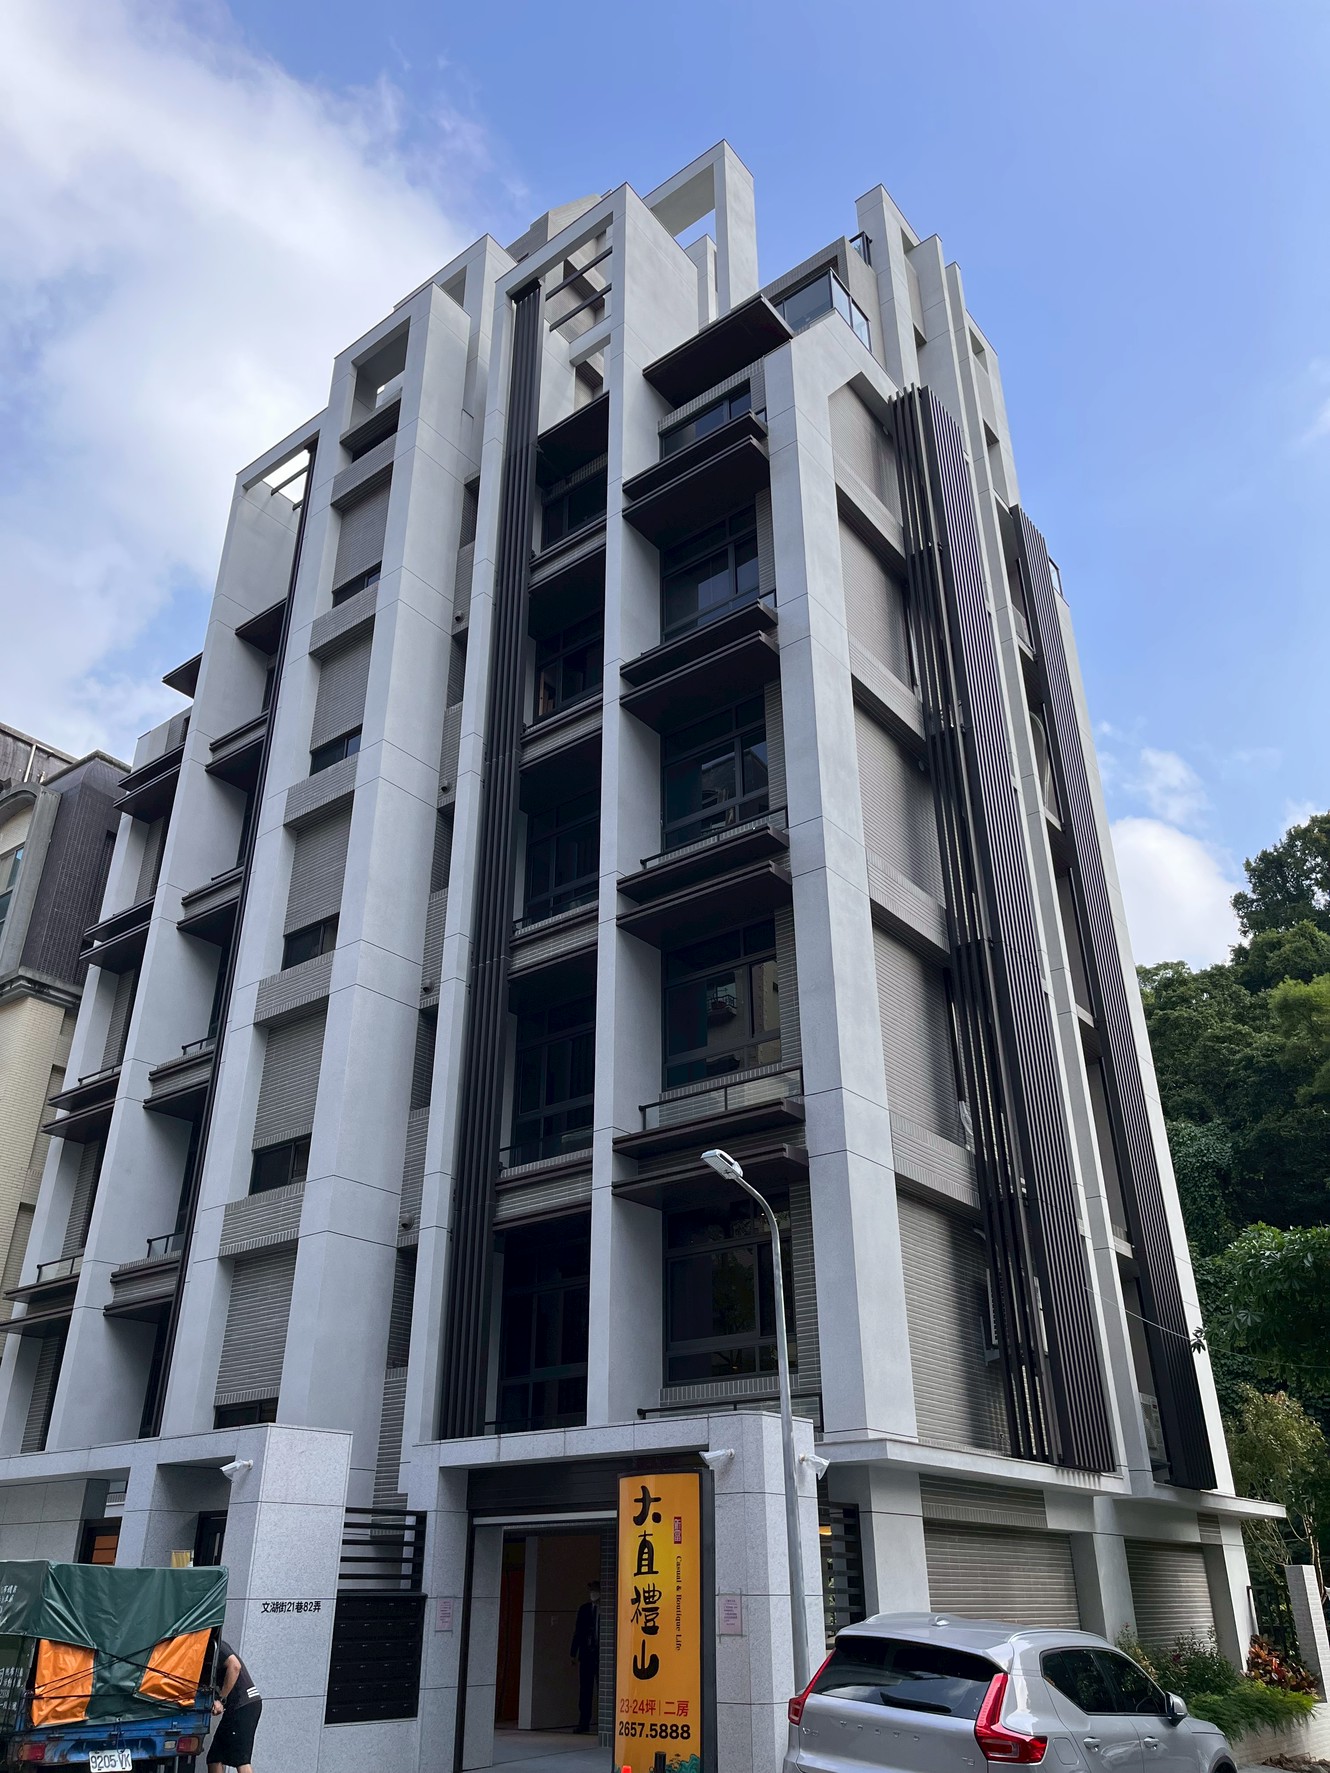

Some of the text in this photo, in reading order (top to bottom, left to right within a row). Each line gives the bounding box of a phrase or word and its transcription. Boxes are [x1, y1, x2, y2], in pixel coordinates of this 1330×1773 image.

[631, 1485, 662, 1680] 大直禮山
[261, 1601, 321, 1613] 文湖街21巷82弄
[618, 1721, 691, 1740] 2657.5888
